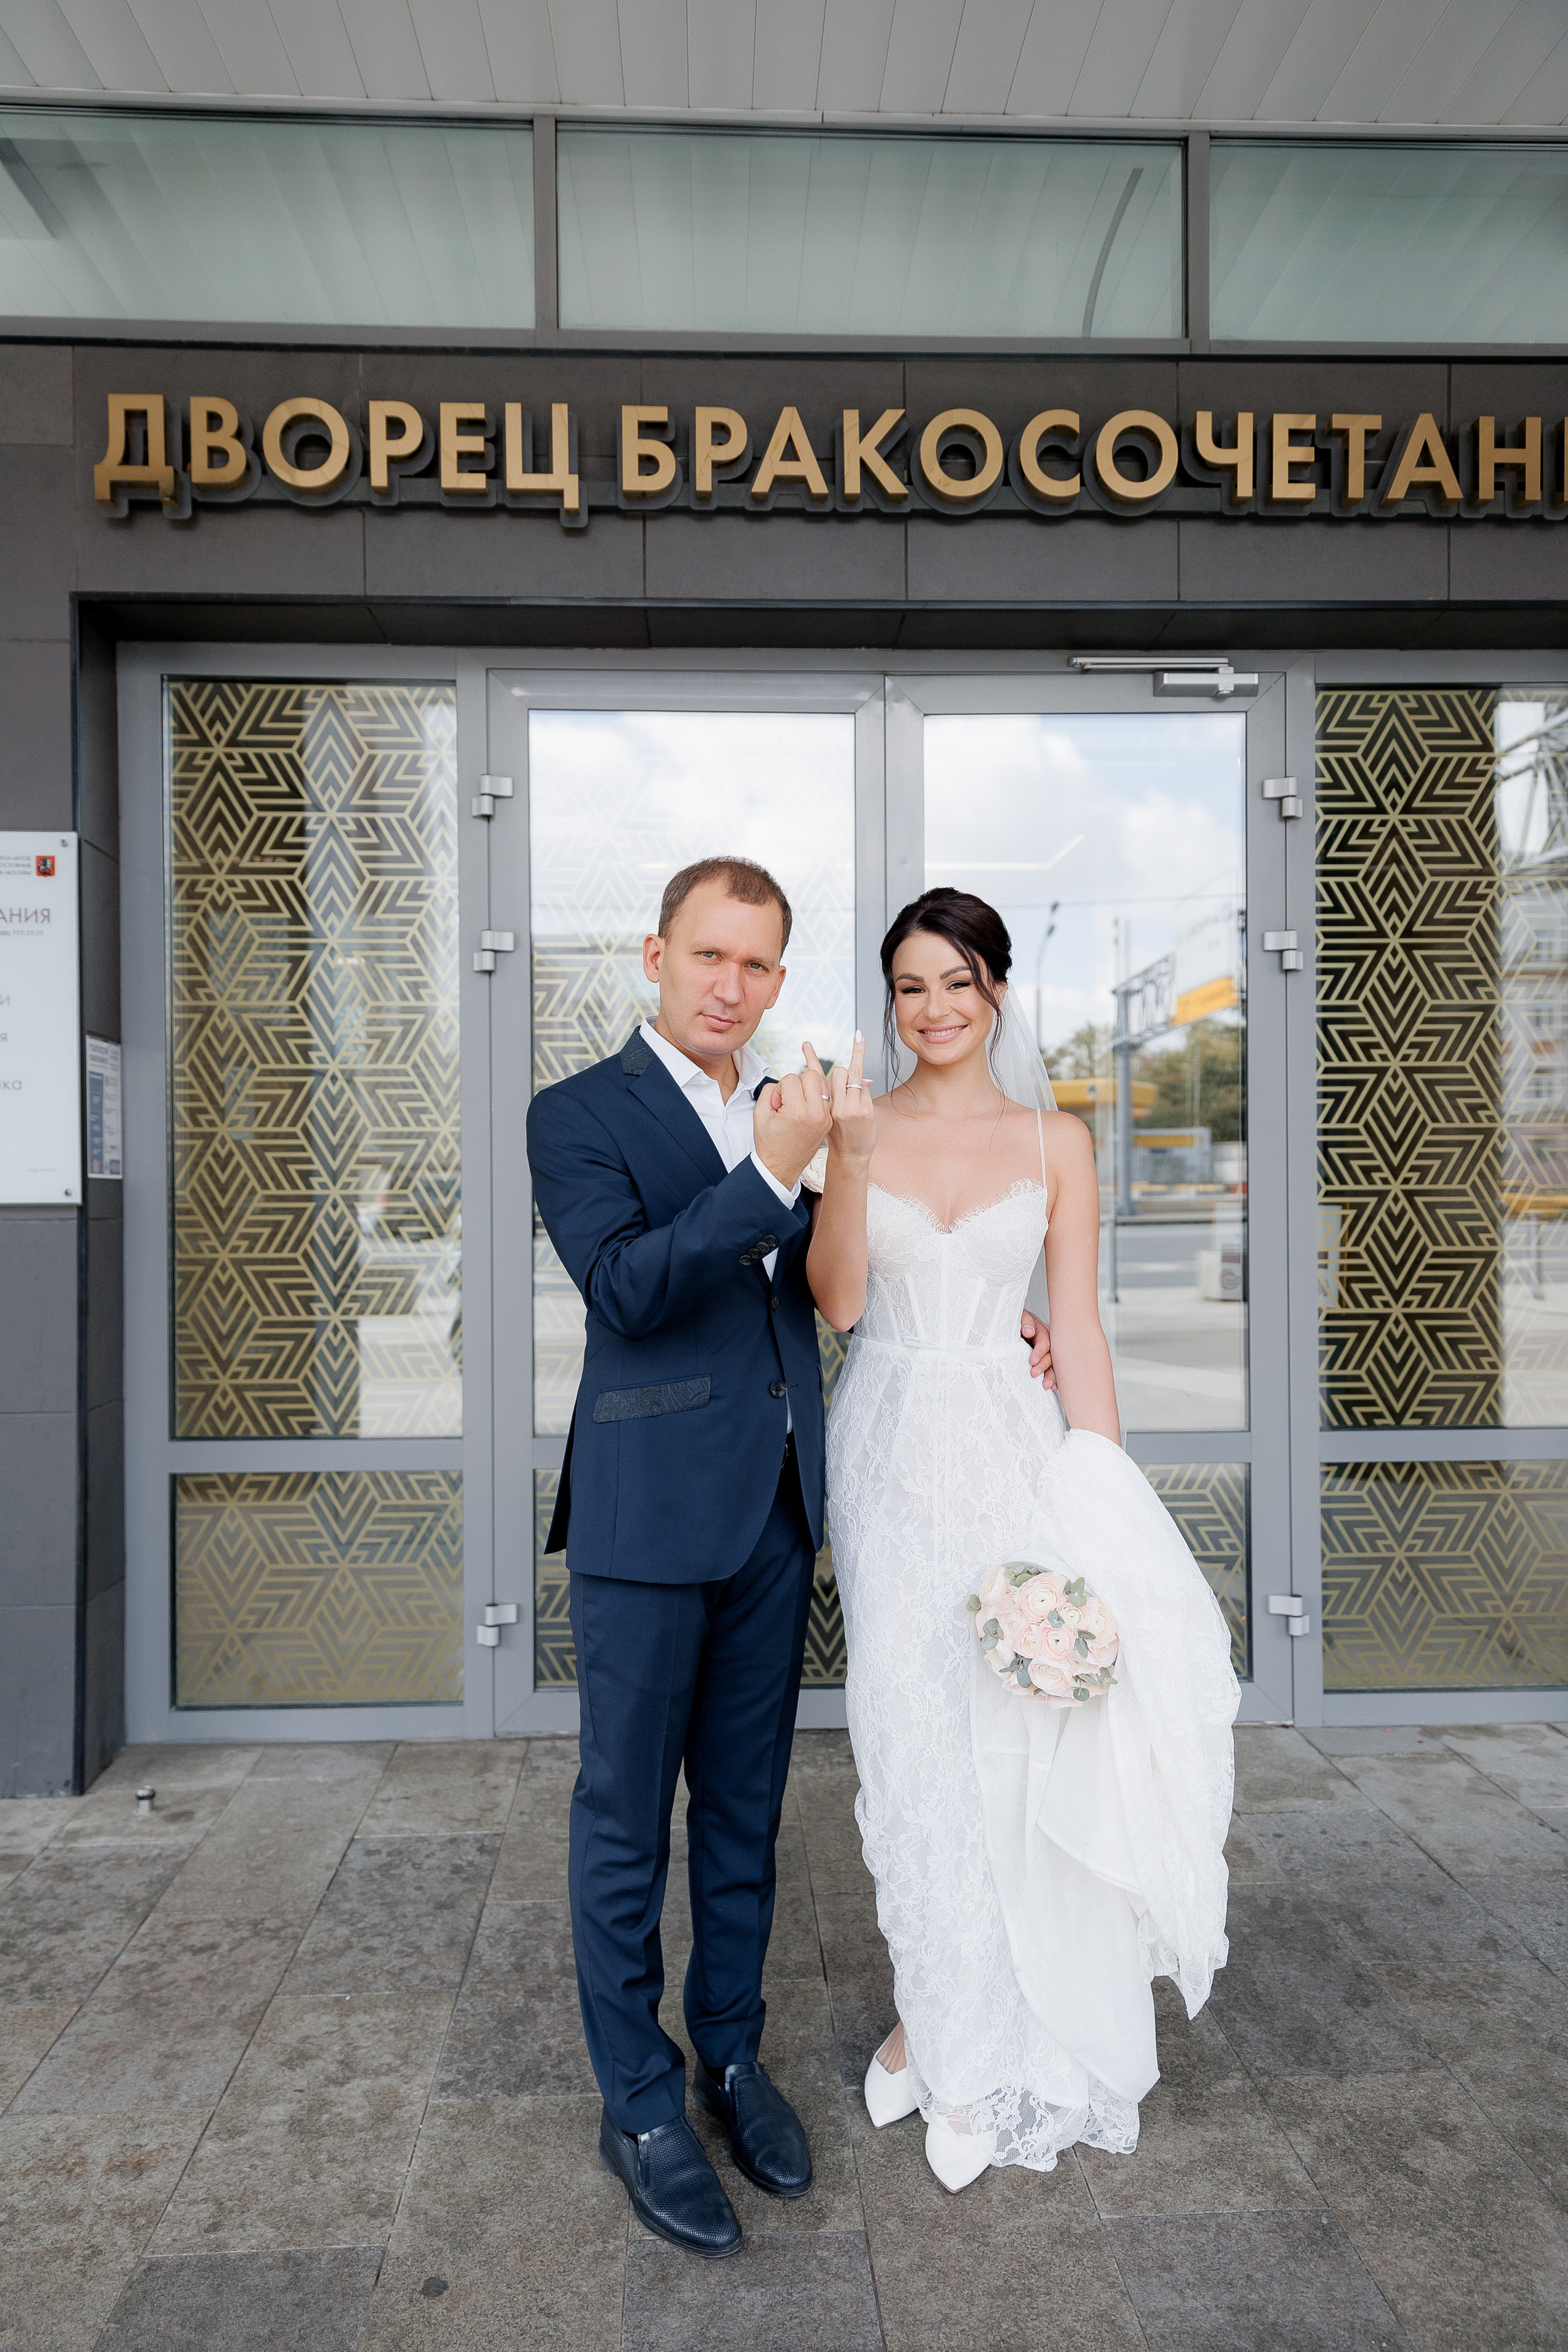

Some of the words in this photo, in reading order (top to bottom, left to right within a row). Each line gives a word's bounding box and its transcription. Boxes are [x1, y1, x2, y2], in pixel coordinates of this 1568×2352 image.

[94, 393, 581, 513] ДВОРЕЦ
[619, 404, 1568, 503] БРАКОСОЧЕТАН
[0, 1080, 23, 1091] ка
